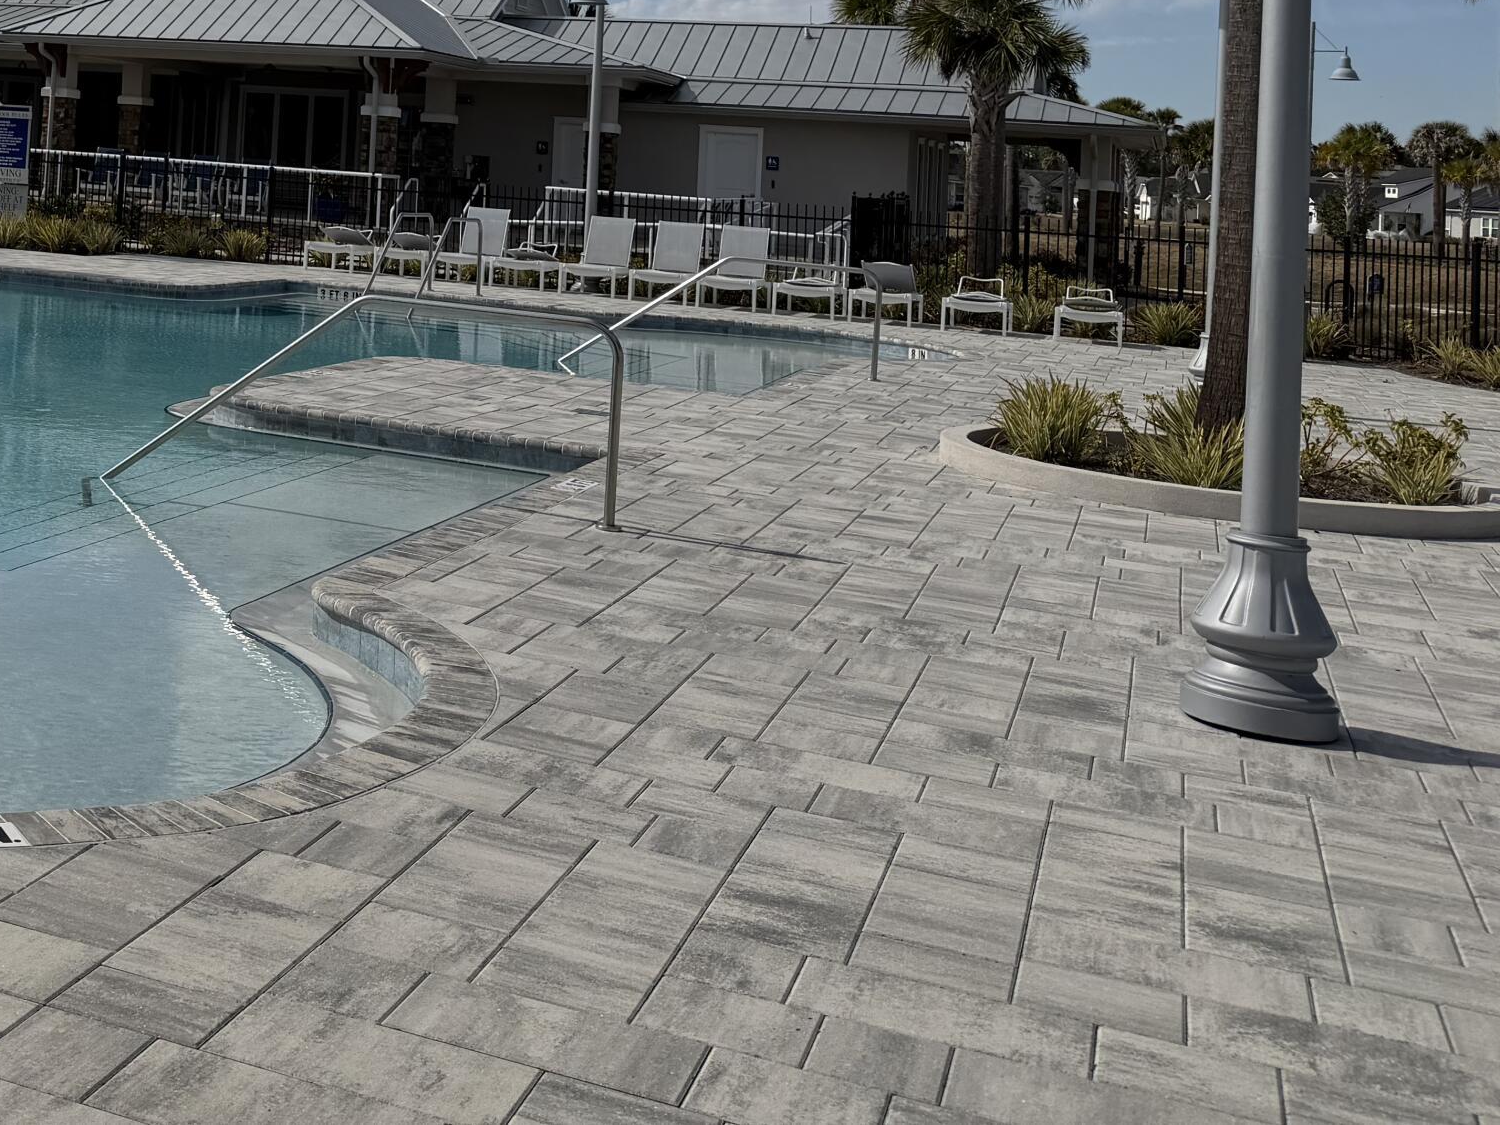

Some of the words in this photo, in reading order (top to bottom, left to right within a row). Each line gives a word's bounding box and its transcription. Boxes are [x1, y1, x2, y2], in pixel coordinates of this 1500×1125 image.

[14, 196, 24, 204] AT
[320, 288, 326, 300] 3
[329, 289, 340, 301] FT
[918, 349, 926, 360] IN
